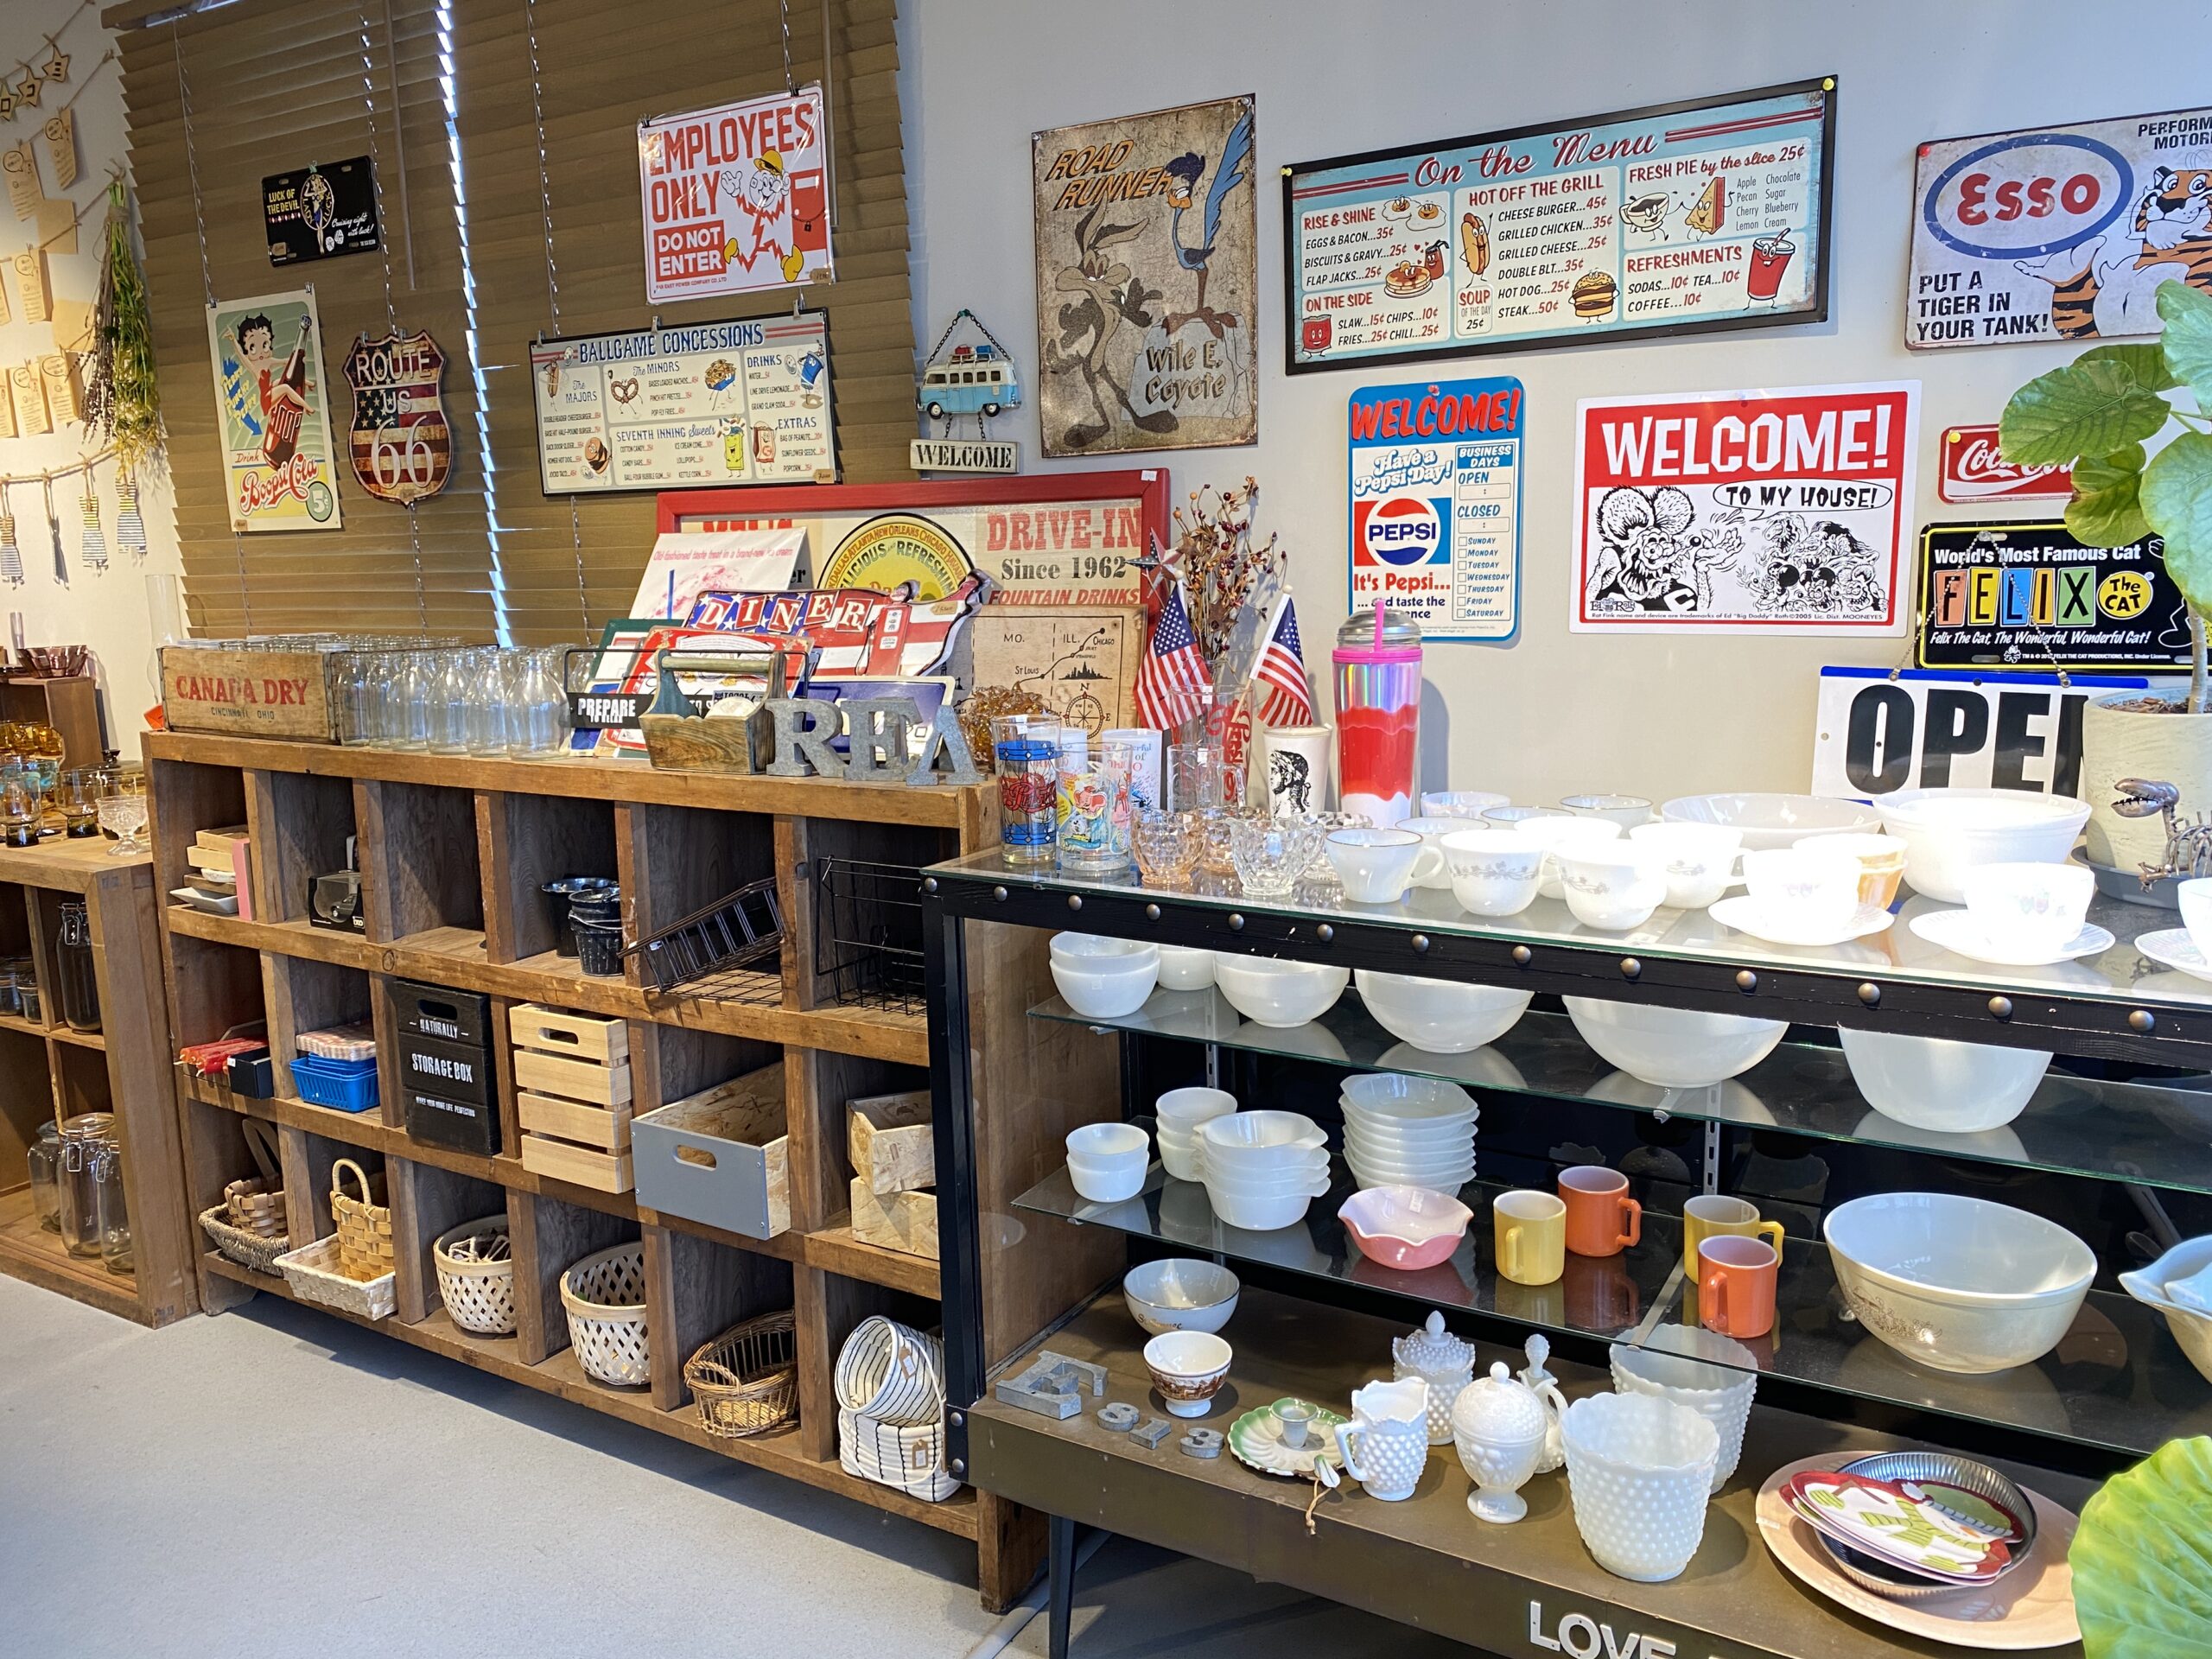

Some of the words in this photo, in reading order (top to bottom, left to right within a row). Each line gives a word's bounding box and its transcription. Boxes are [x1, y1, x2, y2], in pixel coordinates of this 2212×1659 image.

[646, 103, 814, 175] EMPLOYEES
[1045, 140, 1134, 181] ROAD
[1415, 156, 1464, 188] On
[1468, 145, 1538, 178] the
[1552, 132, 1658, 168] Menu
[1629, 163, 1672, 183] FRESH
[1676, 160, 1698, 175] PIE
[1700, 160, 1718, 178] by
[1720, 154, 1741, 169] the
[1744, 151, 1776, 167] slice
[1778, 144, 1805, 162] 25¢
[1052, 166, 1173, 211] RUNNER
[1737, 176, 1757, 189] Apple
[1765, 172, 1801, 186] Chocolate
[269, 190, 285, 203] LUCK
[287, 188, 296, 199] OF
[652, 171, 720, 223] ONLY
[1469, 189, 1497, 207] HOT
[1499, 185, 1526, 203] OFF
[1530, 181, 1559, 196] THE
[1561, 174, 1604, 194] GRILL
[1737, 191, 1758, 202] Pecan
[1765, 189, 1785, 201] Sugar
[1957, 173, 2101, 226] ESSO
[267, 206, 280, 214] THE
[280, 200, 300, 213] DEVIL
[1498, 208, 1535, 222] CHEESE
[1736, 205, 1758, 218] Cherry
[1764, 200, 1799, 214] Blueberry
[1305, 214, 1328, 231] RISE
[1331, 213, 1341, 226] &
[1343, 207, 1376, 225] SHINE
[1736, 219, 1758, 232] Lemon
[1764, 218, 1787, 228] Cream
[658, 234, 683, 252] DO
[686, 227, 721, 250] NOT
[1306, 238, 1328, 250] EGGS
[1498, 229, 1538, 242] GRILLED
[659, 250, 722, 276] ENTER
[1305, 254, 1343, 268] BISCUITS
[1498, 248, 1538, 260] GRILLED
[1627, 245, 1743, 273] REFRESHMENTS
[1306, 275, 1328, 286] FLAP
[1498, 267, 1537, 280] DOUBLE
[1919, 272, 1961, 295] PUT
[1968, 270, 1983, 289] A
[1306, 297, 1321, 312] ON
[1324, 295, 1344, 309] THE
[1346, 292, 1373, 308] SIDE
[1459, 289, 1491, 306] SOUP
[1498, 287, 1517, 299] HOT
[1470, 306, 1480, 316] THE
[1481, 305, 1491, 315] DAY
[1917, 296, 1980, 318] TIGER
[1988, 292, 2011, 312] IN
[1466, 317, 1484, 330] 25¢
[1916, 319, 1974, 341] YOUR
[1983, 314, 2049, 337] TANK!
[580, 335, 656, 363] BALLGAME
[663, 323, 764, 354] CONCESSIONS
[356, 346, 431, 383] ROUTE
[747, 354, 782, 367] DRINKS
[1147, 340, 1196, 372] Wile
[1203, 340, 1223, 369] E.
[633, 366, 645, 376] The
[647, 361, 680, 374] MINORS
[573, 380, 585, 390] The
[1146, 372, 1226, 410] Coyote
[383, 391, 411, 414] US
[566, 391, 597, 404] MAJORS
[778, 417, 817, 429] EXTRAS
[1351, 388, 1522, 441] WELCOME!
[617, 430, 654, 442] SEVENTH
[657, 427, 686, 439] INNING
[689, 424, 715, 438] Sweets
[1602, 404, 1891, 478] WELCOME!
[235, 452, 260, 463] Drink
[372, 415, 434, 489] 66
[916, 444, 1011, 468] WELCOME
[1459, 446, 1511, 458] BUSINESS
[1374, 448, 1423, 476] Have
[1470, 457, 1500, 467] DAYS
[1354, 473, 1407, 497] Pepsi
[1409, 460, 1453, 487] Day!
[1459, 472, 1490, 485] OPEN
[1726, 486, 1751, 506] TO
[1760, 486, 1794, 506] MY
[1801, 486, 1878, 509] HOUSE!
[1458, 505, 1501, 518] CLOSED
[890, 525, 919, 537] ORLEANS
[987, 507, 1141, 551] DRIVE-IN
[1369, 523, 1436, 542] PEPSI
[1935, 549, 1994, 564] World's
[1999, 547, 2039, 563] Most
[2044, 547, 2107, 562] Famous
[2113, 545, 2140, 560] Cat
[1001, 558, 1060, 580] Since
[1071, 556, 1126, 579] 1962
[1354, 572, 1379, 591] It's
[2110, 577, 2140, 594] The
[989, 589, 1074, 605] FOUNTAIN
[1076, 588, 1140, 605] DRINKS
[1396, 597, 1424, 607] taste
[1427, 596, 1446, 607] the
[1942, 571, 2090, 622] FELIX
[2105, 594, 2141, 612] CAT
[698, 594, 866, 632] DINER
[1004, 634, 1025, 643] MO.
[1063, 635, 1080, 644] ILL.
[1093, 635, 1115, 645] CHICAGO
[1930, 633, 1952, 645] Felix
[1954, 632, 1971, 645] The
[1995, 632, 2011, 645] The
[2071, 631, 2122, 645] Wonderful
[2123, 631, 2151, 644] Cat!
[263, 678, 308, 706] DRY
[1080, 683, 1090, 691] N
[257, 710, 275, 720] OHIO
[577, 698, 636, 717] PREPARE
[420, 1019, 458, 1039] NATURALLY
[411, 1053, 453, 1078] STORAGE
[454, 1062, 473, 1084] BOX
